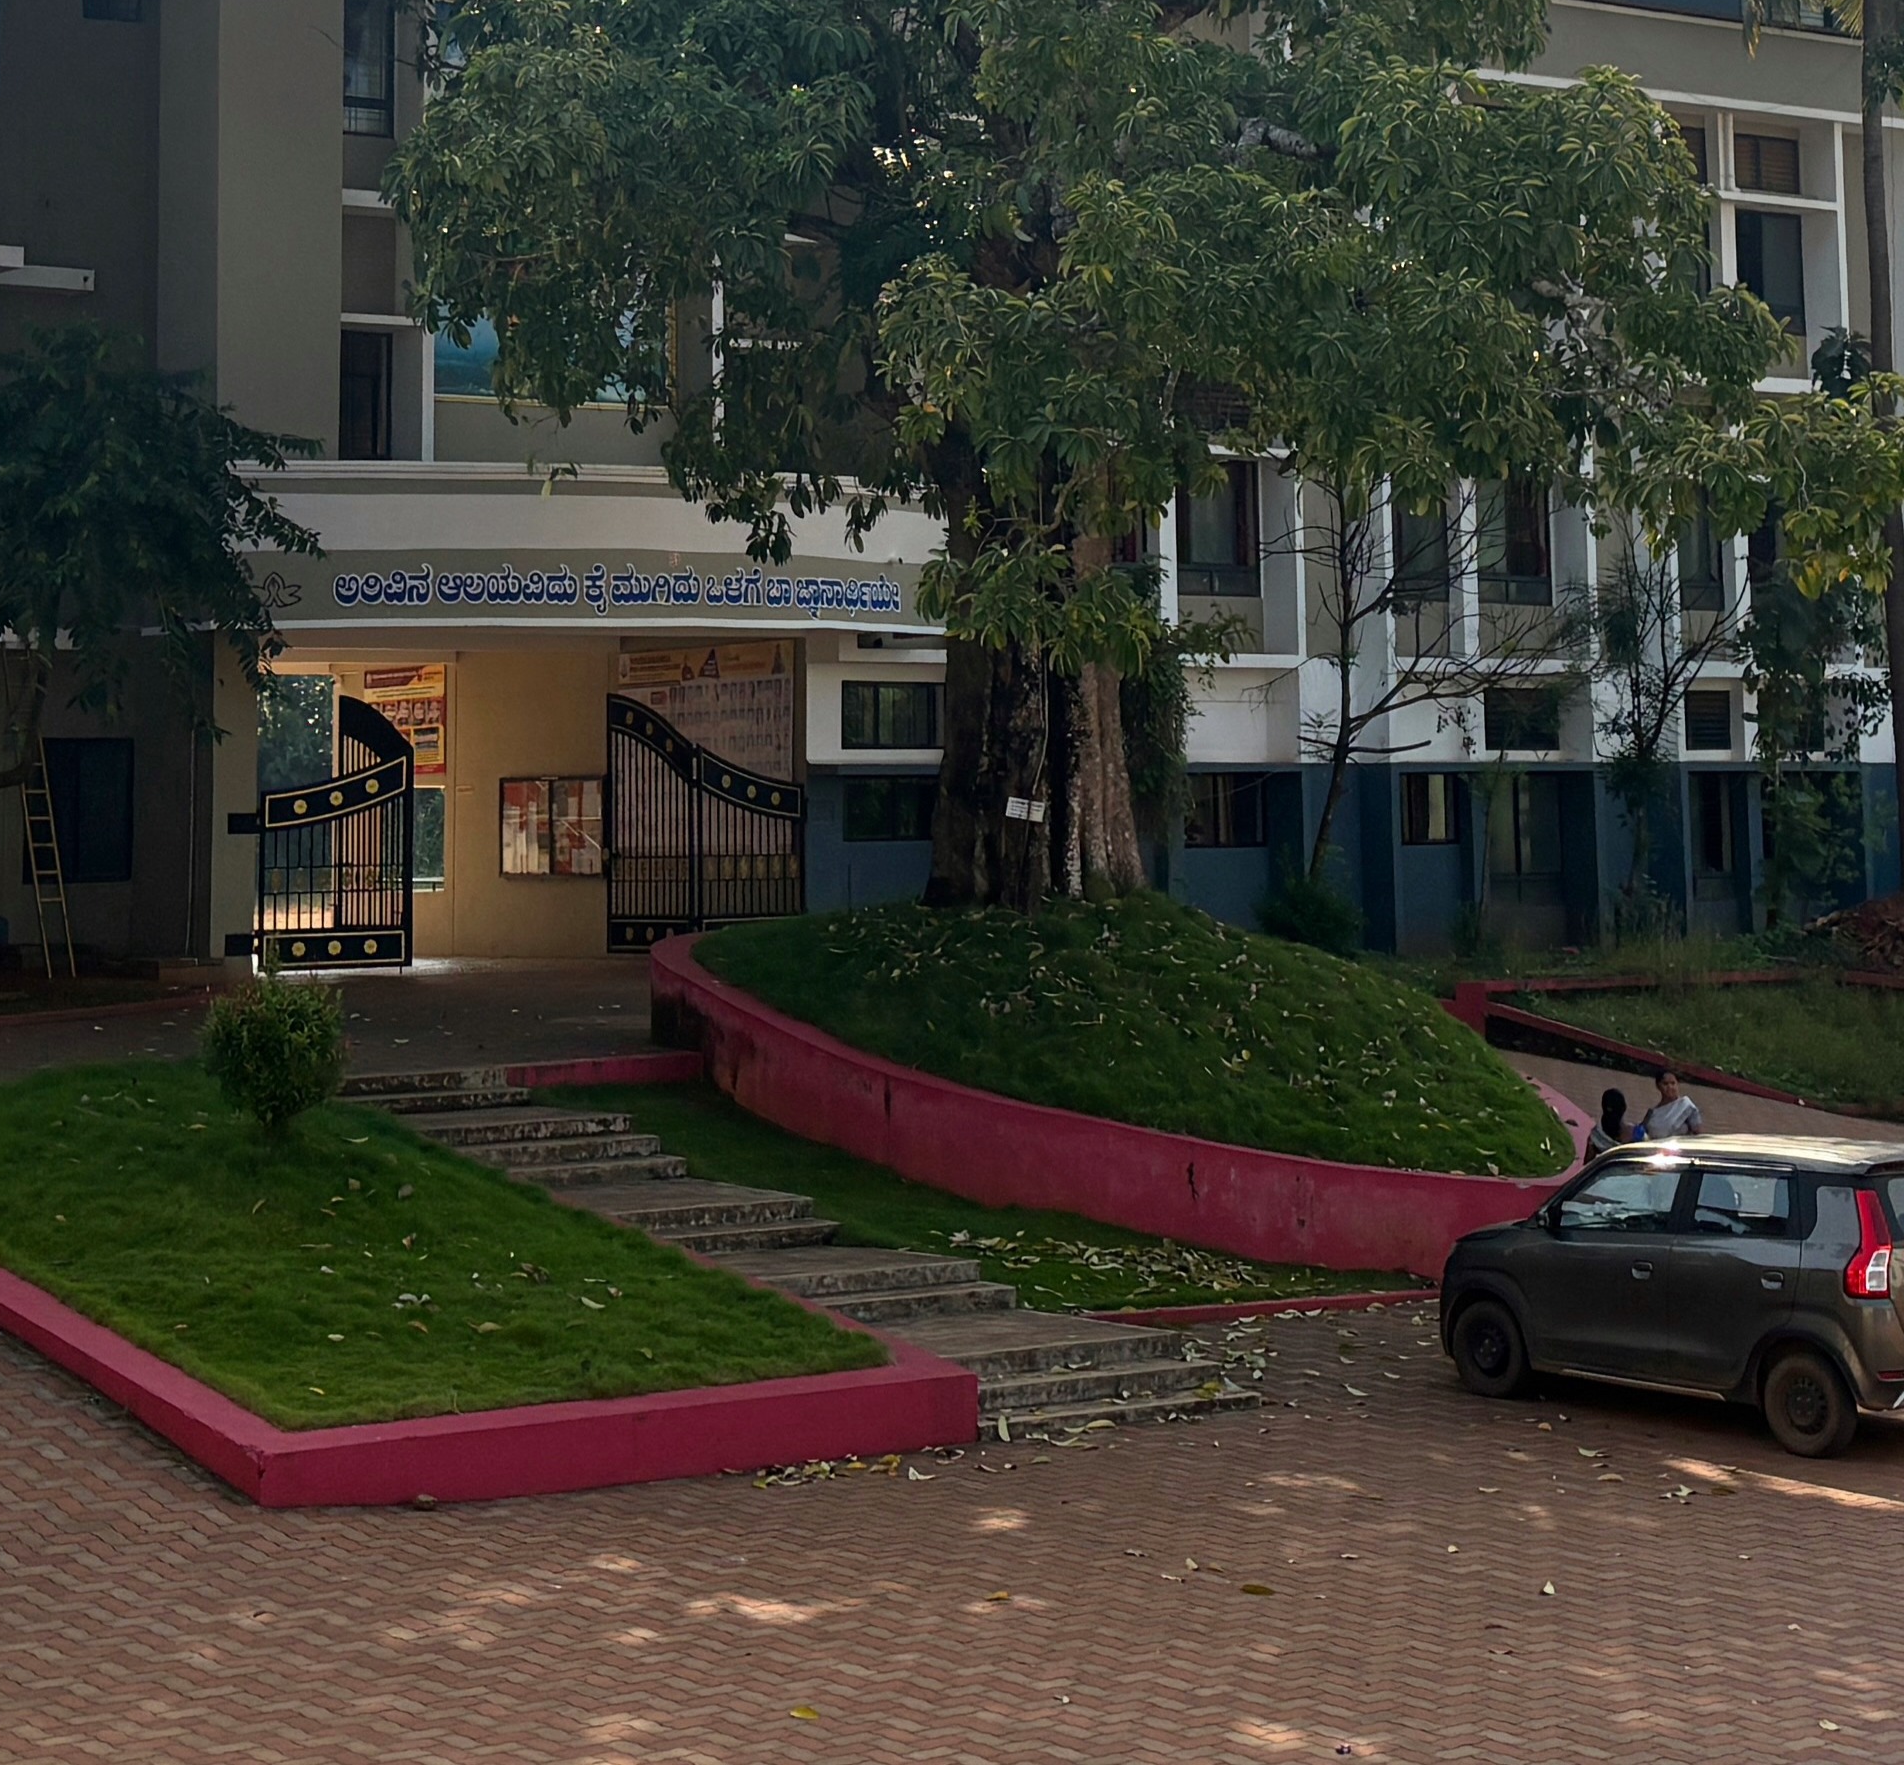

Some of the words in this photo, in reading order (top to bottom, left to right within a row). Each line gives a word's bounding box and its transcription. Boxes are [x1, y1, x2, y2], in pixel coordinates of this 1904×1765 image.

[333, 563, 433, 606] ಅರಿವಿನ
[436, 563, 578, 605] ಆಲಯವಿದು
[583, 562, 608, 616] ಕೈ
[610, 563, 702, 606] ಮುಗಿದು
[704, 565, 762, 607] ಒಳಗೆ
[765, 577, 794, 608] ಬಾ
